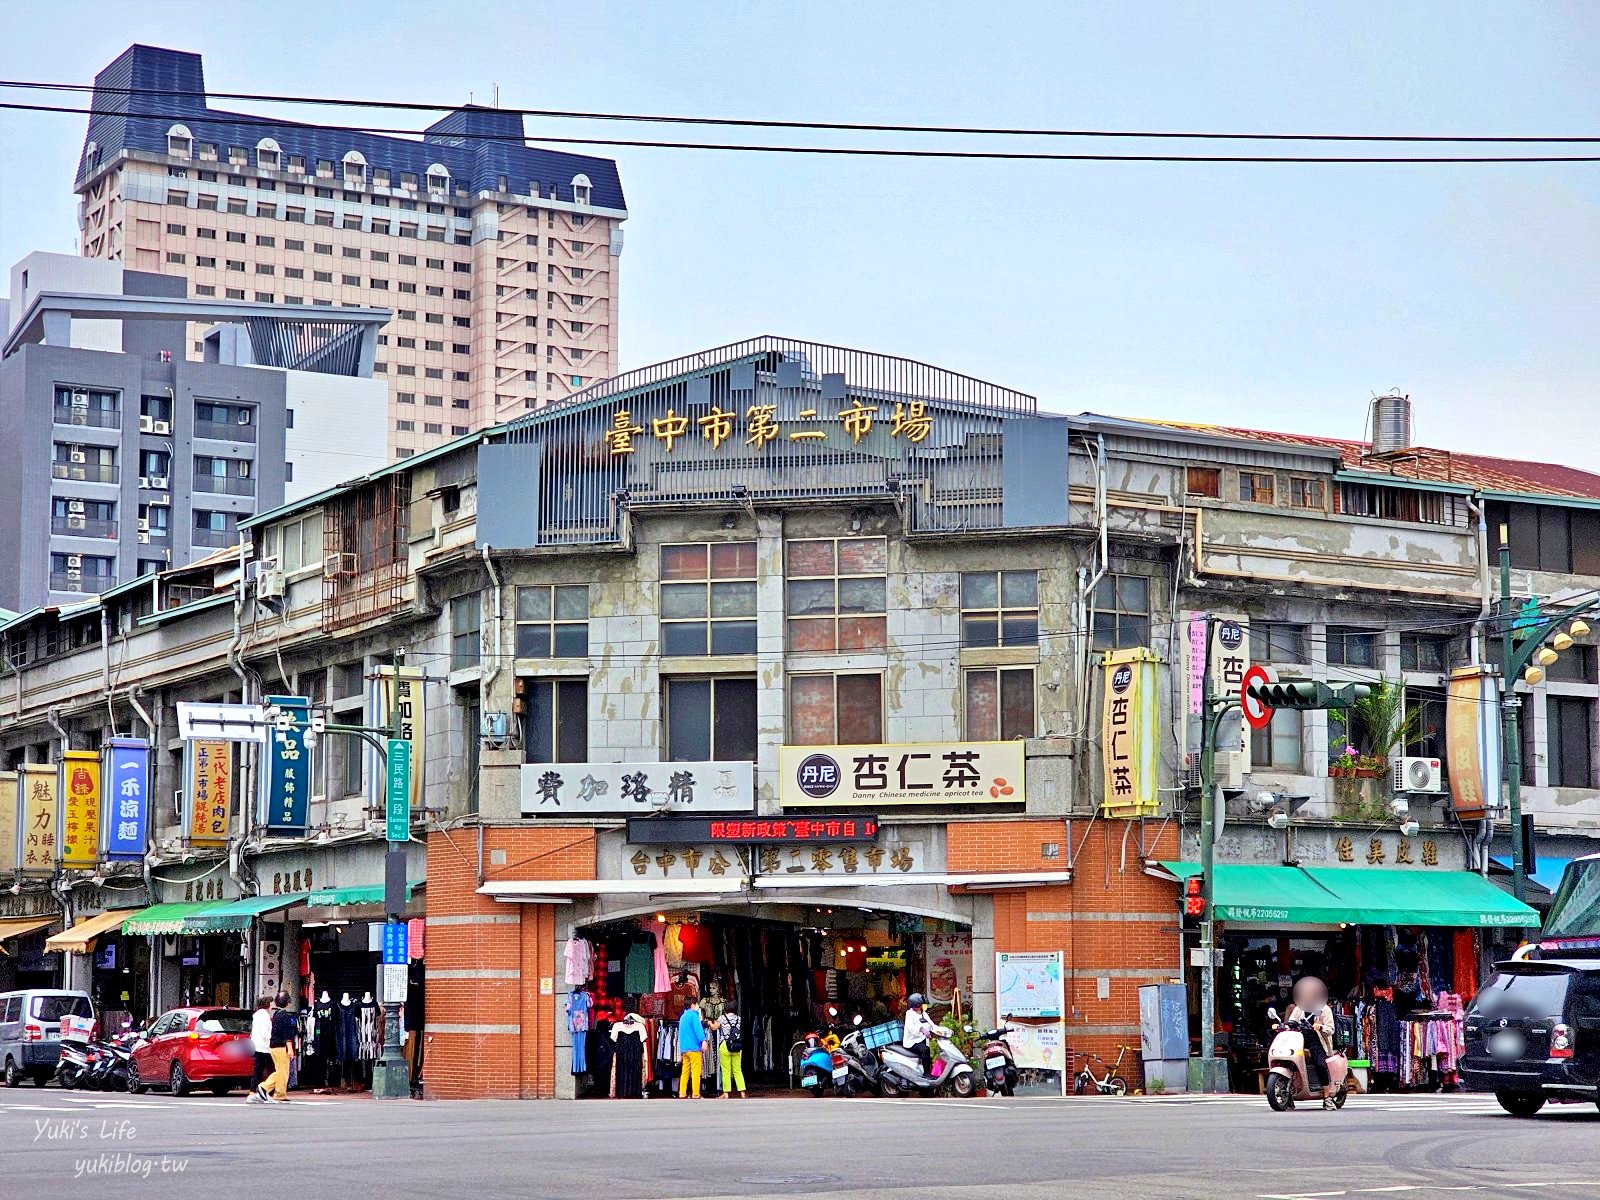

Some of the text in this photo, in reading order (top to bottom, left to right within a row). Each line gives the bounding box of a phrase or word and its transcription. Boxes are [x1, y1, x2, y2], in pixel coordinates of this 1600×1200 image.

[604, 400, 934, 455] 臺中市第二市場
[1222, 627, 1240, 640] 丹尼
[1114, 671, 1130, 684] 丹尼
[852, 751, 981, 790] 杏仁茶
[1111, 697, 1132, 796] 杏仁茶
[212, 748, 229, 833] 三代老店肉包
[283, 768, 296, 822] 服飾精品
[393, 752, 404, 815] 三民路二段
[802, 766, 835, 782] 丹尼
[32, 780, 52, 830] 魅力
[67, 797, 79, 845] 愛玉檸檬
[41, 833, 54, 864] 睡衣
